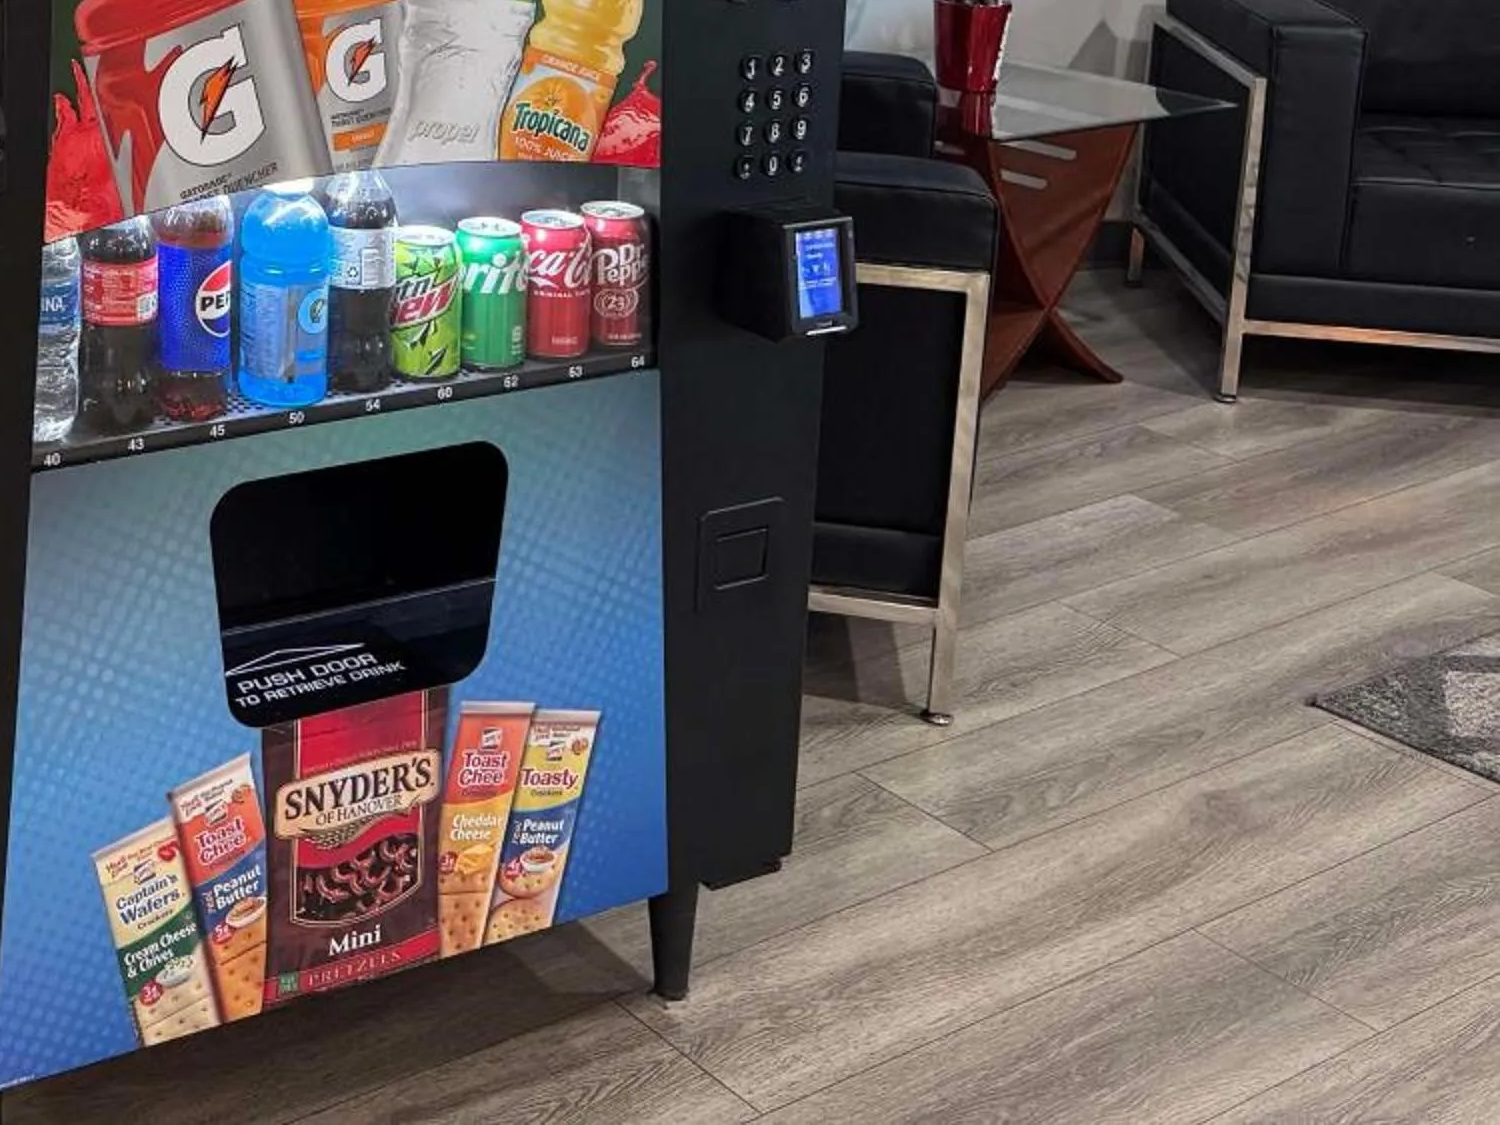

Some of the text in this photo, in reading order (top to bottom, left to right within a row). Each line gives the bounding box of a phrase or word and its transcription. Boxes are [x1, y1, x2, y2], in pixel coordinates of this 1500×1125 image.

[326, 19, 387, 103] G
[747, 59, 755, 79] 1
[774, 56, 784, 76] 2
[801, 53, 811, 74] 3
[159, 23, 267, 167] G
[745, 92, 755, 112] 4
[772, 91, 781, 110] 5
[798, 87, 809, 107] 6
[513, 101, 590, 152] Tropicana
[742, 126, 752, 146] 7
[770, 123, 780, 143] 8
[797, 120, 807, 139] 9
[768, 156, 778, 175] 0
[180, 172, 231, 199] GATORADE
[618, 244, 644, 265] Dr
[607, 296, 625, 310] 23
[631, 356, 645, 367] 64
[437, 387, 452, 399] 60
[366, 400, 380, 411] 54
[289, 413, 304, 424] 50
[209, 425, 225, 437] 45
[128, 438, 145, 451] 43
[44, 453, 61, 466] 40
[238, 653, 378, 694] PUSH DOOR
[235, 661, 407, 708] TO RETRIEVE DRINK
[464, 751, 510, 770] Toast
[459, 768, 504, 786] Chee
[522, 768, 579, 789] Toasty
[285, 756, 432, 820] SNYDER'S
[316, 797, 402, 826] OF HANOVER
[453, 813, 502, 829] Cheddar
[195, 816, 244, 848] Toast
[451, 828, 491, 841] Cheese
[523, 818, 564, 832] Peanut
[520, 832, 558, 844] Butter
[199, 833, 246, 865] Chee
[214, 864, 261, 896] Peanut
[116, 873, 179, 910] Captain's
[215, 880, 259, 910] Butter
[120, 887, 180, 925] Wafers
[124, 922, 197, 967] Cream Cheese
[329, 925, 382, 956] Mini
[127, 949, 175, 979] & Chives
[308, 952, 401, 986] PRETZELS
